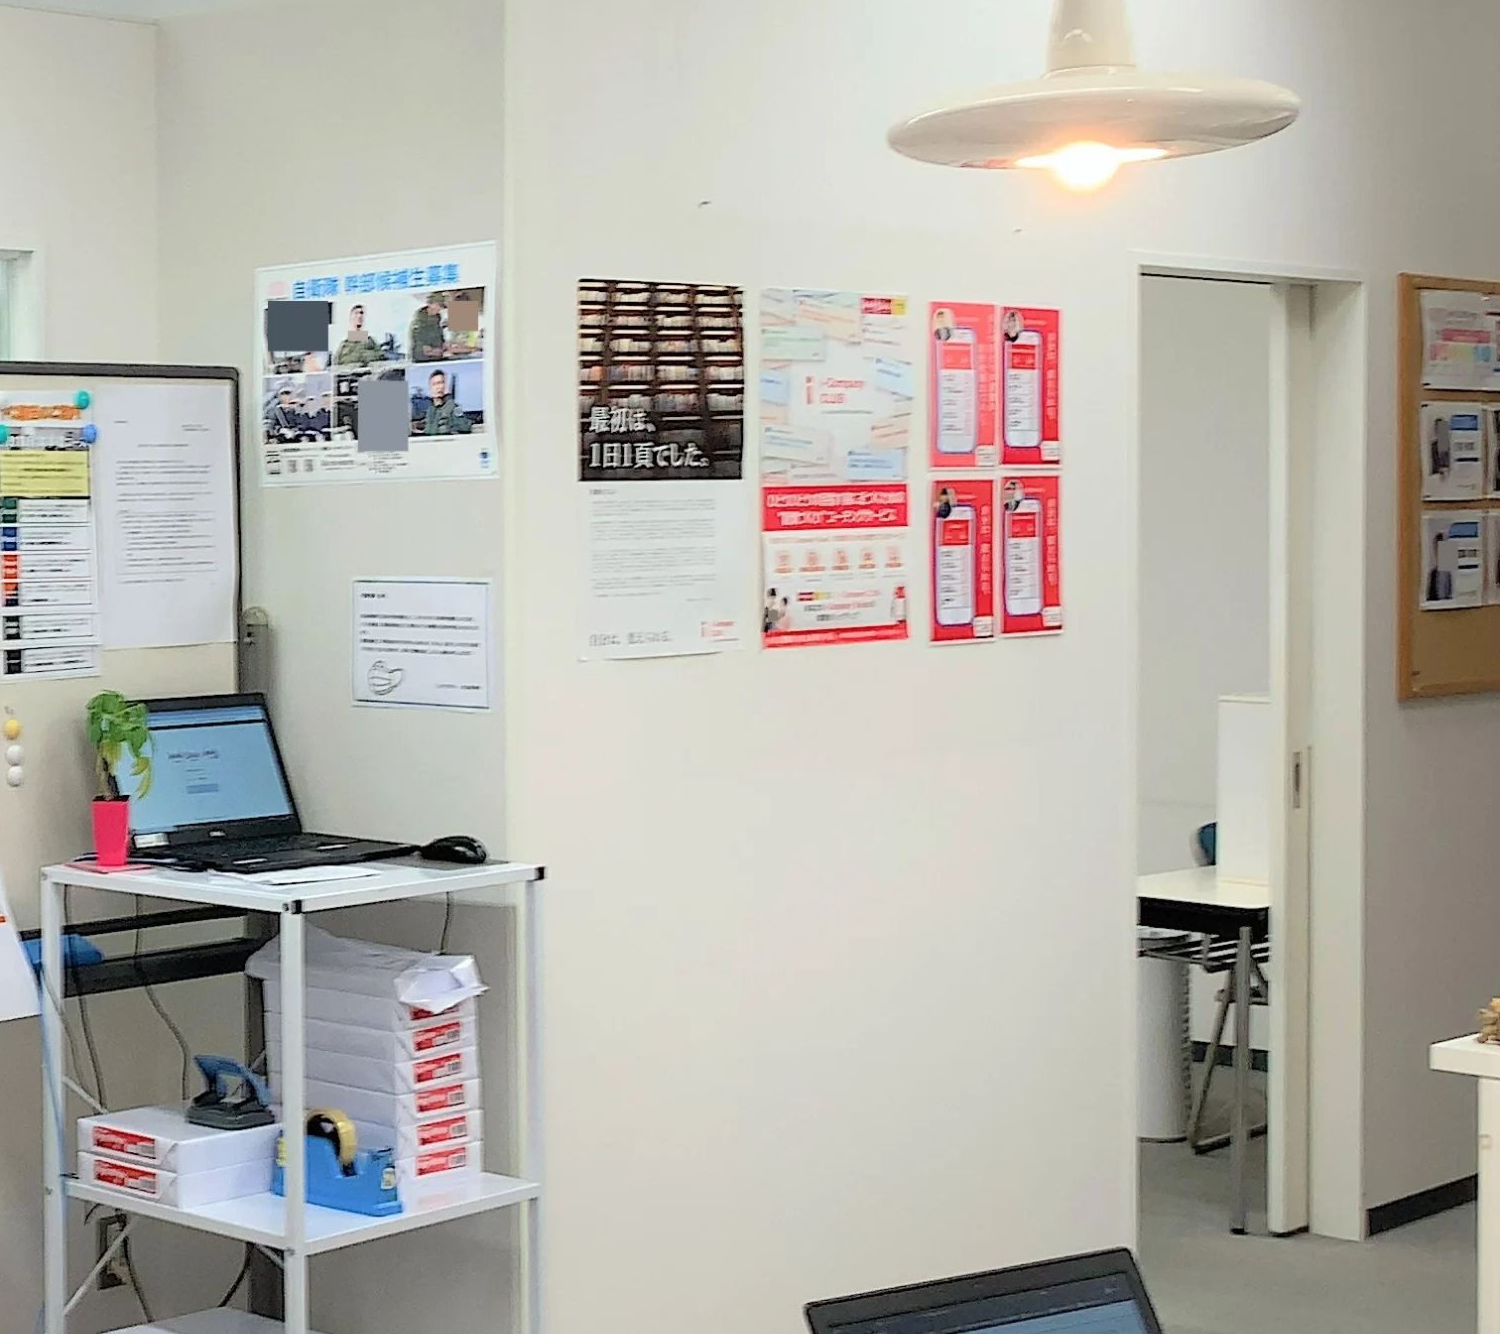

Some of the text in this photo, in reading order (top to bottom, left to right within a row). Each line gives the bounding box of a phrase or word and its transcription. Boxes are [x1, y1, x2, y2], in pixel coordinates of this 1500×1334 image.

[293, 276, 339, 299] 自衛隊
[589, 406, 656, 433] 最初は、
[589, 442, 709, 468] 1日1頁でした。
